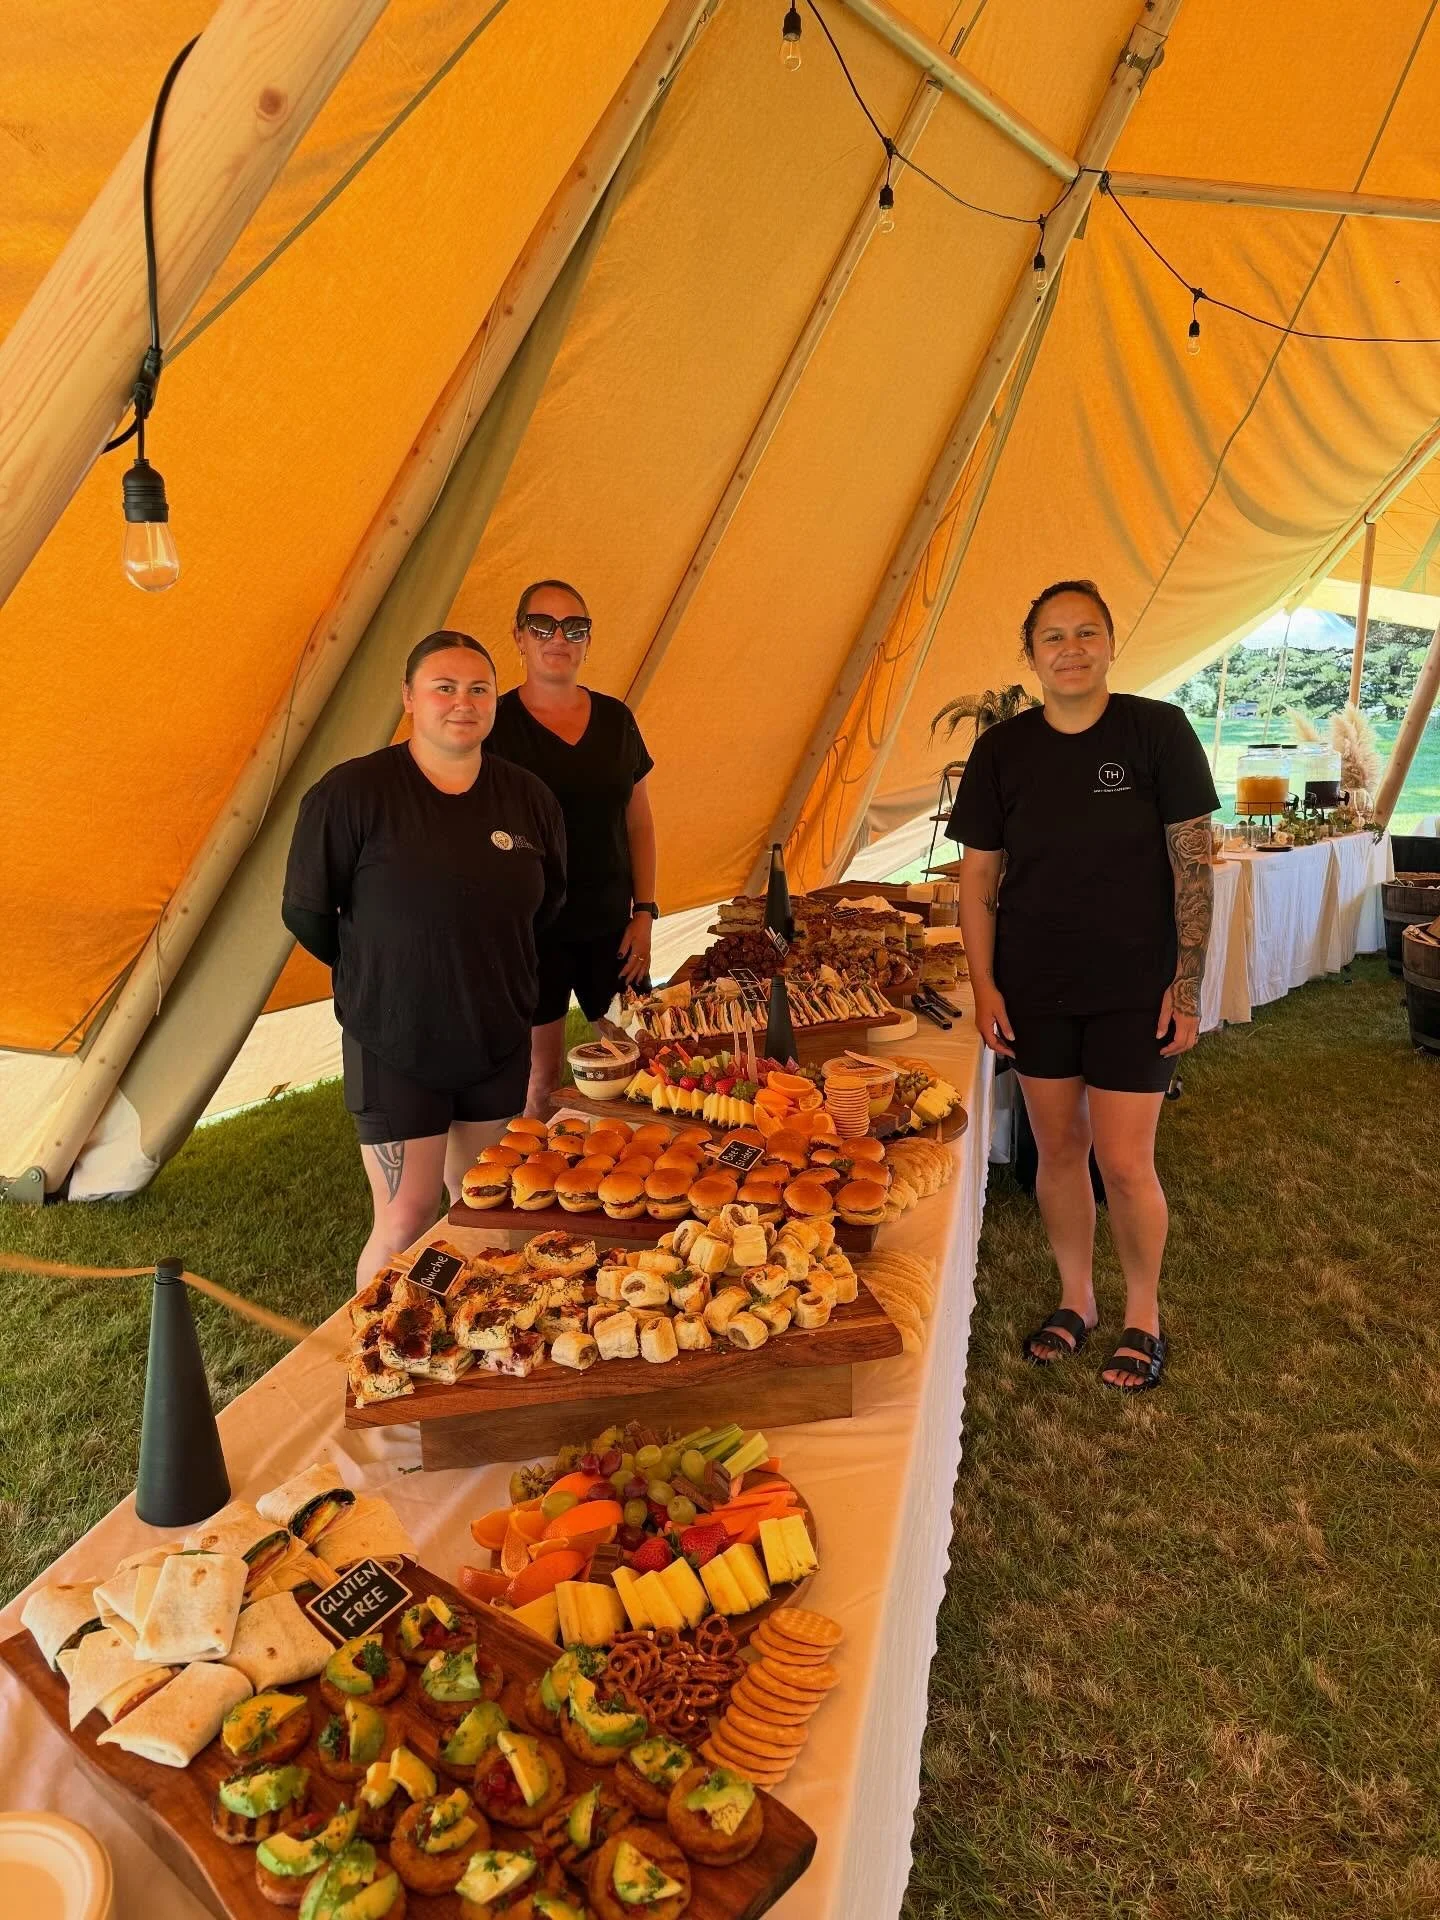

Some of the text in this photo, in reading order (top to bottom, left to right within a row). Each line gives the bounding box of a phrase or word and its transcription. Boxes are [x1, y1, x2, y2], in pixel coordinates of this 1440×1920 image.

[1104, 770, 1119, 779] TH
[420, 1255, 448, 1287] Quiche
[320, 1560, 379, 1615] GLUTEN
[341, 1586, 389, 1627] FREE
